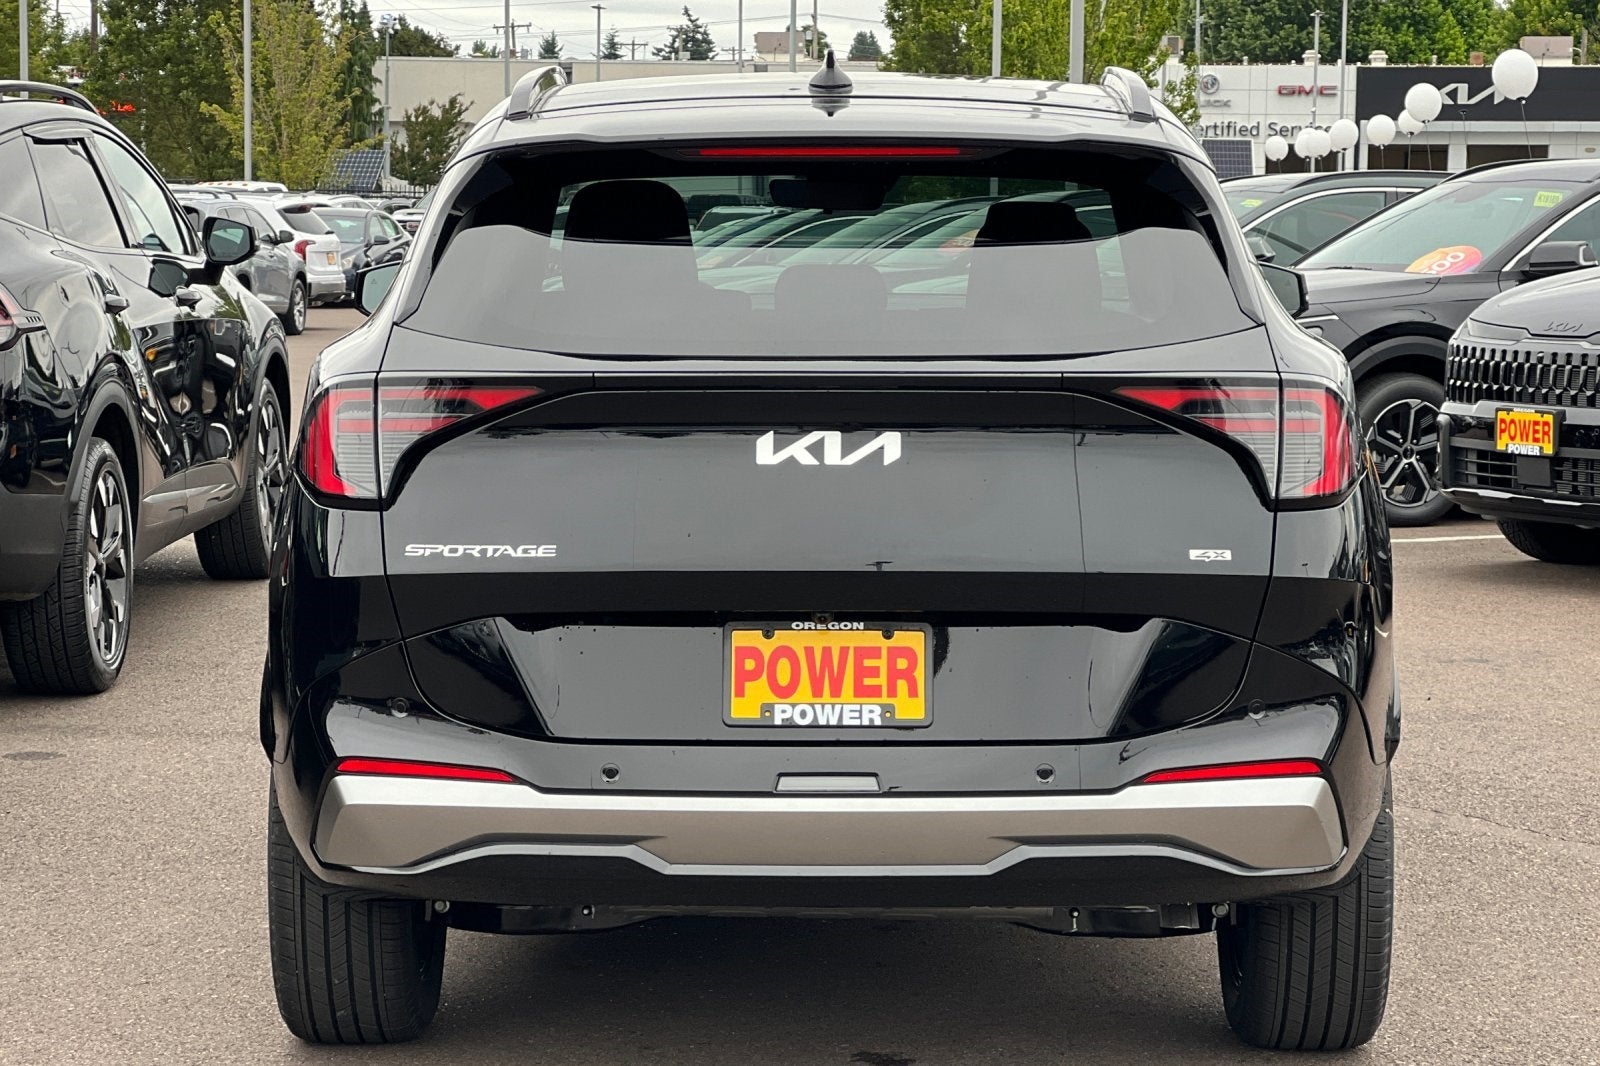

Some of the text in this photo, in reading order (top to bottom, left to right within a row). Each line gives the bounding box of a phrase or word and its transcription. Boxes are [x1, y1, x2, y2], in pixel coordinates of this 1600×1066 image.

[1277, 85, 1338, 97] GMC
[1193, 120, 1260, 137] ertified
[1499, 417, 1551, 444] POWER
[756, 430, 902, 466] KIA
[1508, 443, 1541, 456] POWER
[404, 543, 557, 558] SPORTAGE
[791, 621, 865, 631] OREGON
[734, 645, 919, 699] POWER
[773, 704, 882, 726] POWER
